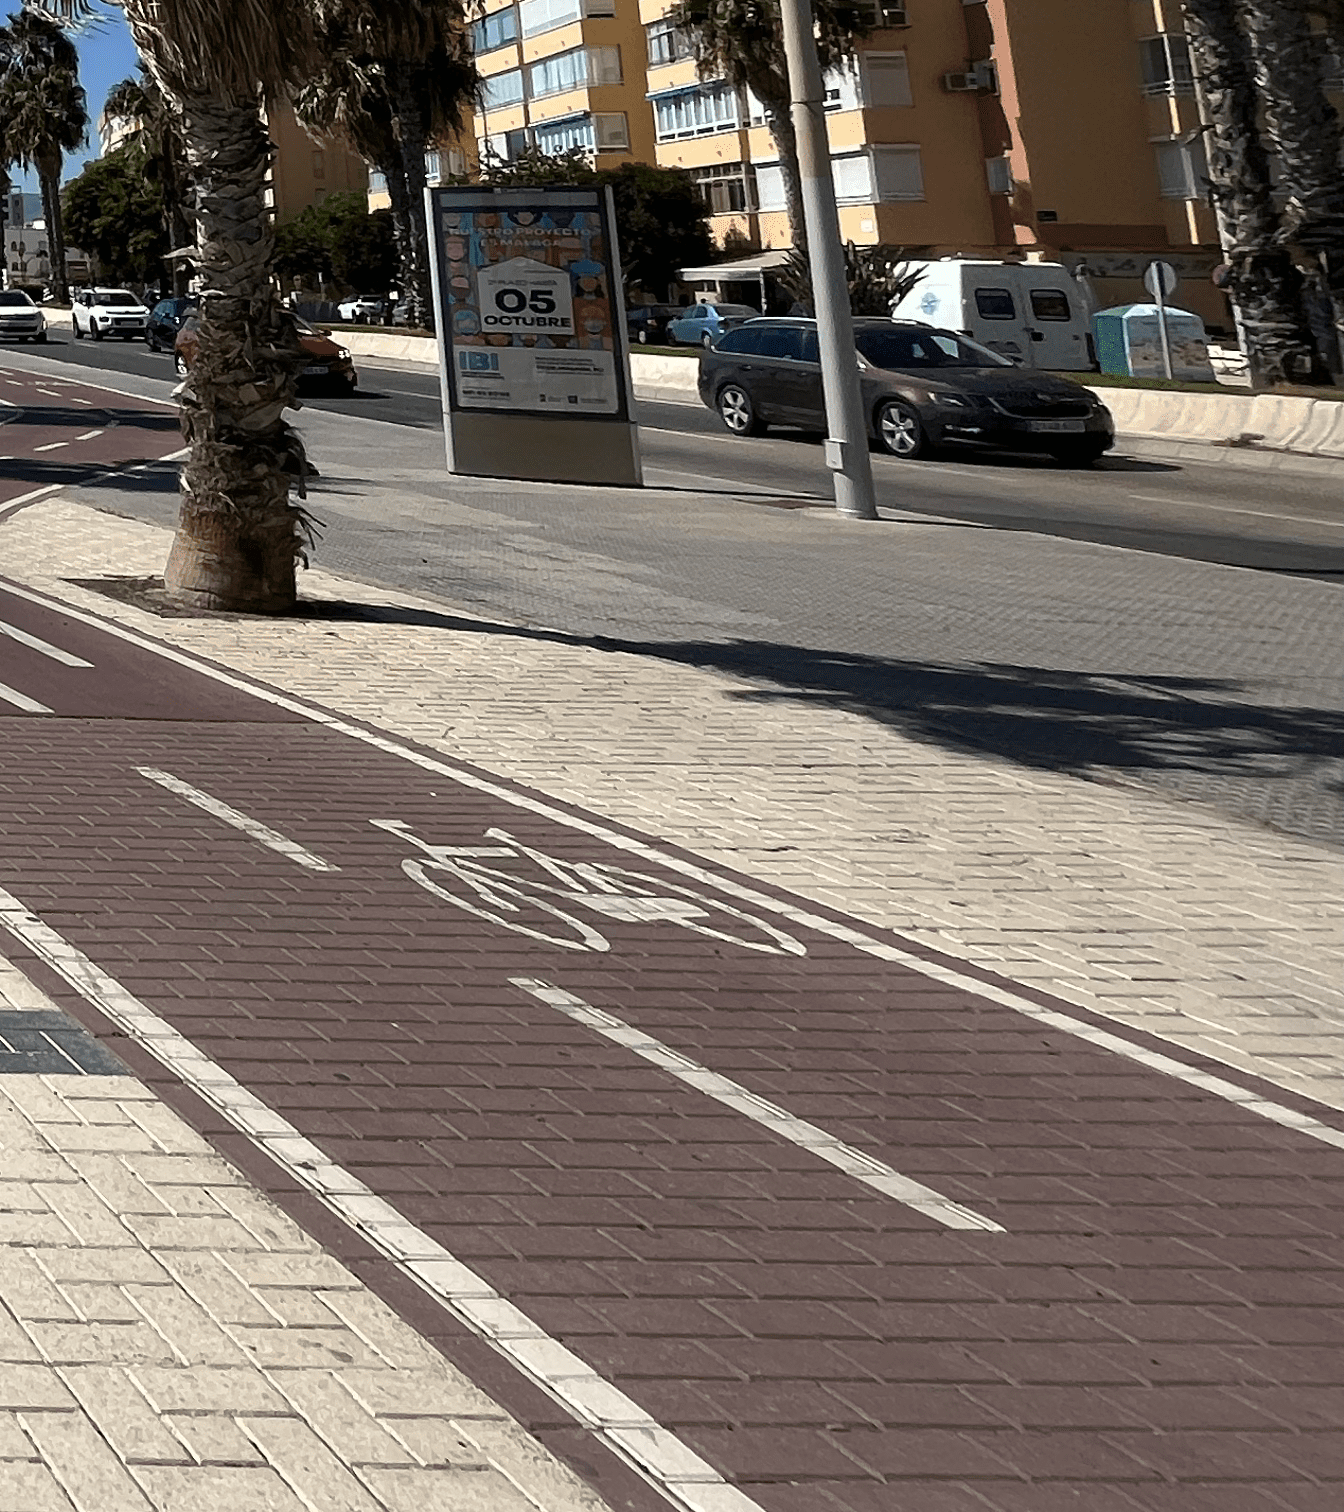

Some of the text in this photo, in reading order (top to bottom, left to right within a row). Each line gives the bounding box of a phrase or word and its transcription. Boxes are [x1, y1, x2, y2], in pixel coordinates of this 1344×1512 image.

[515, 228, 592, 236] PROYECTO
[495, 288, 557, 314] 05
[483, 315, 571, 328] OCTUBRE
[459, 351, 500, 371] IBI
